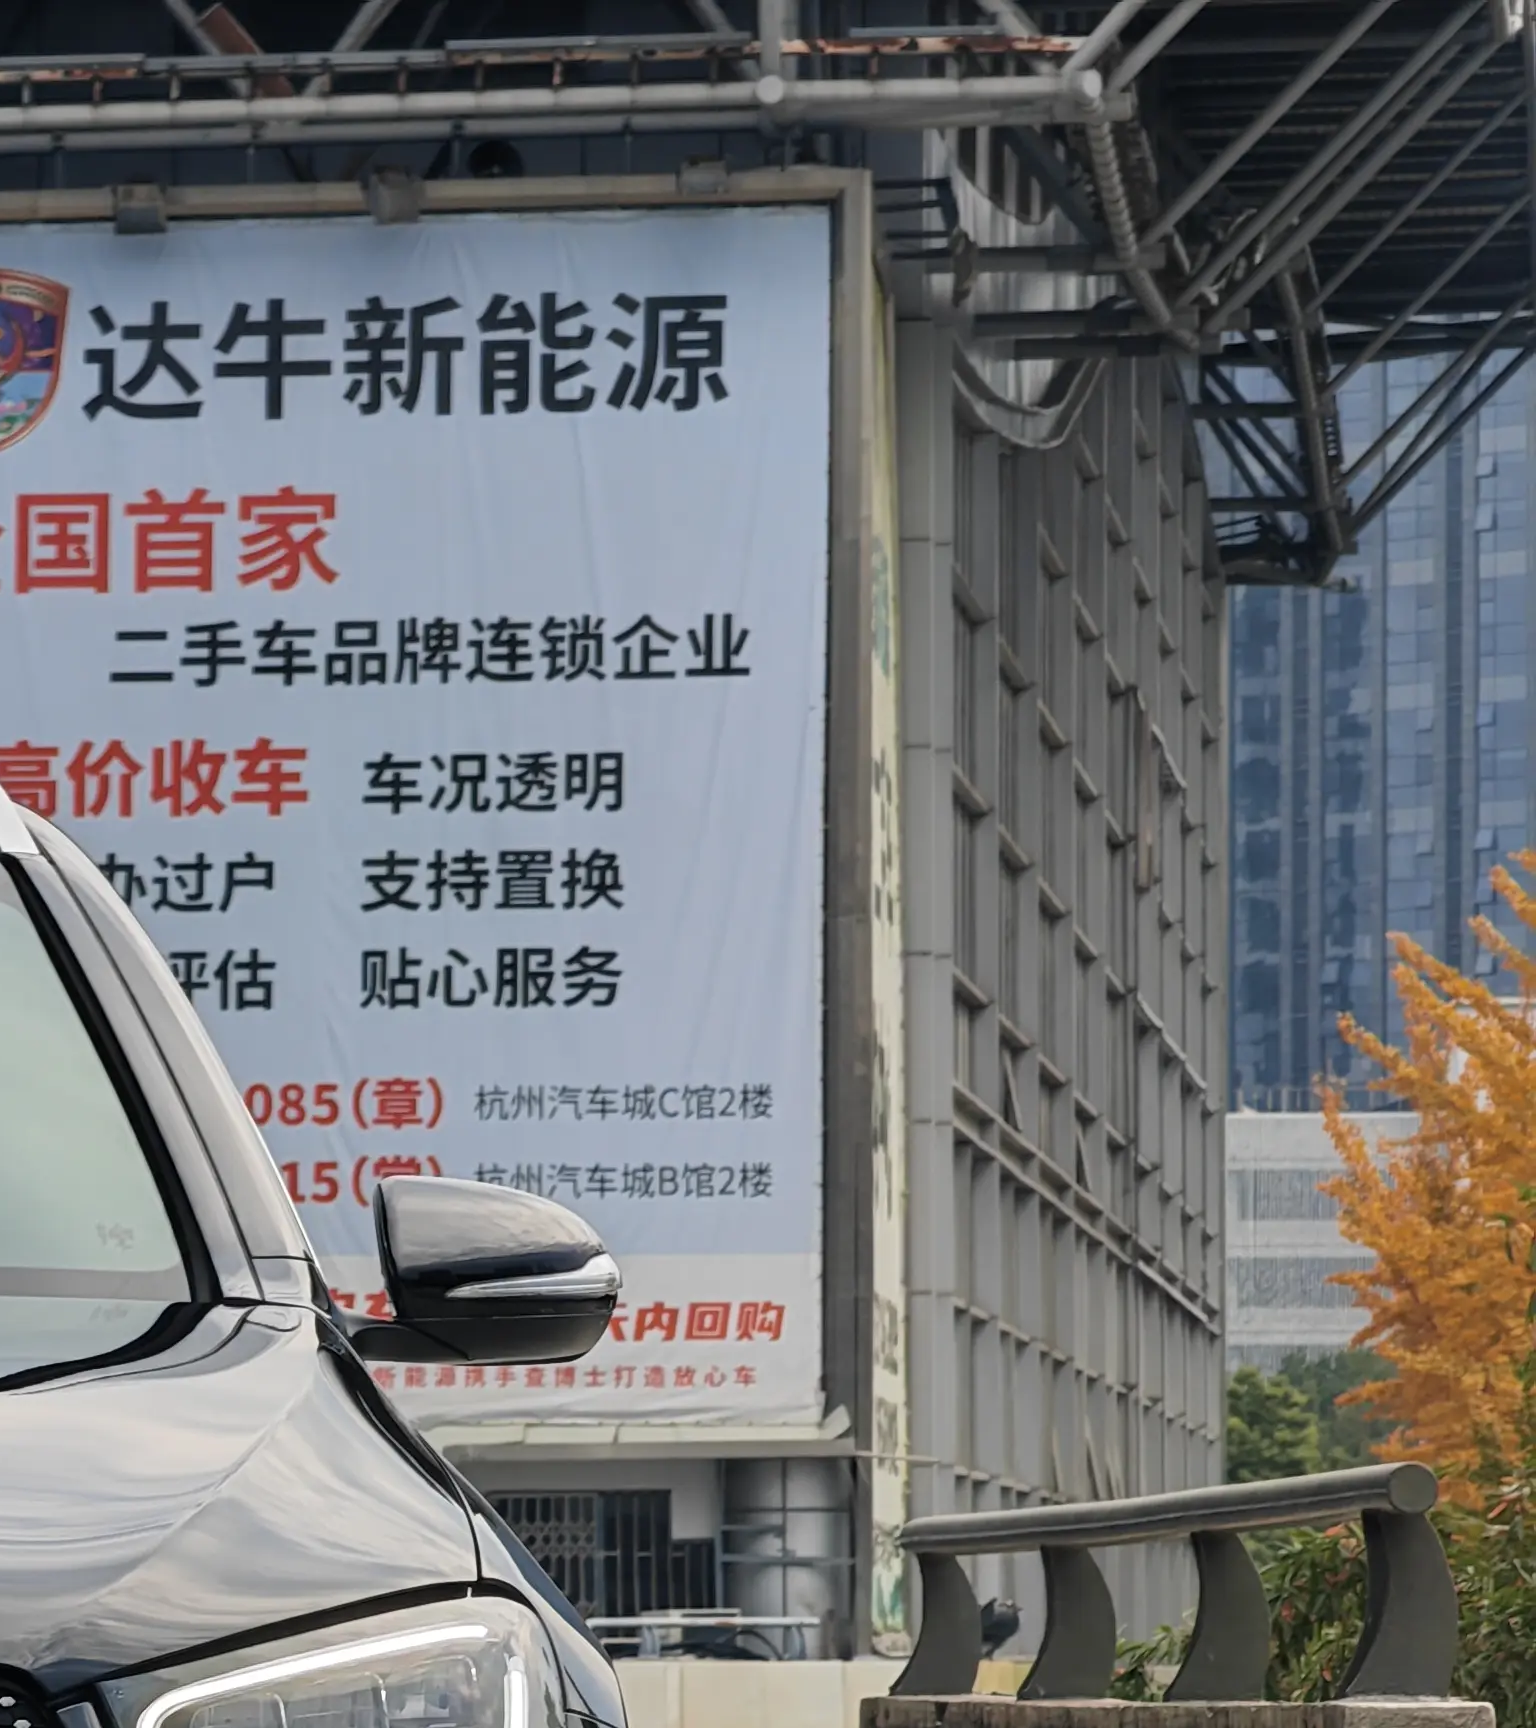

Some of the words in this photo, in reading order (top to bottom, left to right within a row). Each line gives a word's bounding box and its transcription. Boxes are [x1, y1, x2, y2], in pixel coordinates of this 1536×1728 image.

[82, 291, 729, 421] 达牛新能源
[109, 613, 752, 686] 二手车品牌连锁企业
[362, 751, 624, 815] 车况透明
[360, 847, 625, 912] 支持置换
[359, 945, 624, 1010] 贴心服务
[473, 1083, 775, 1121] 杭州汽车城C馆2楼
